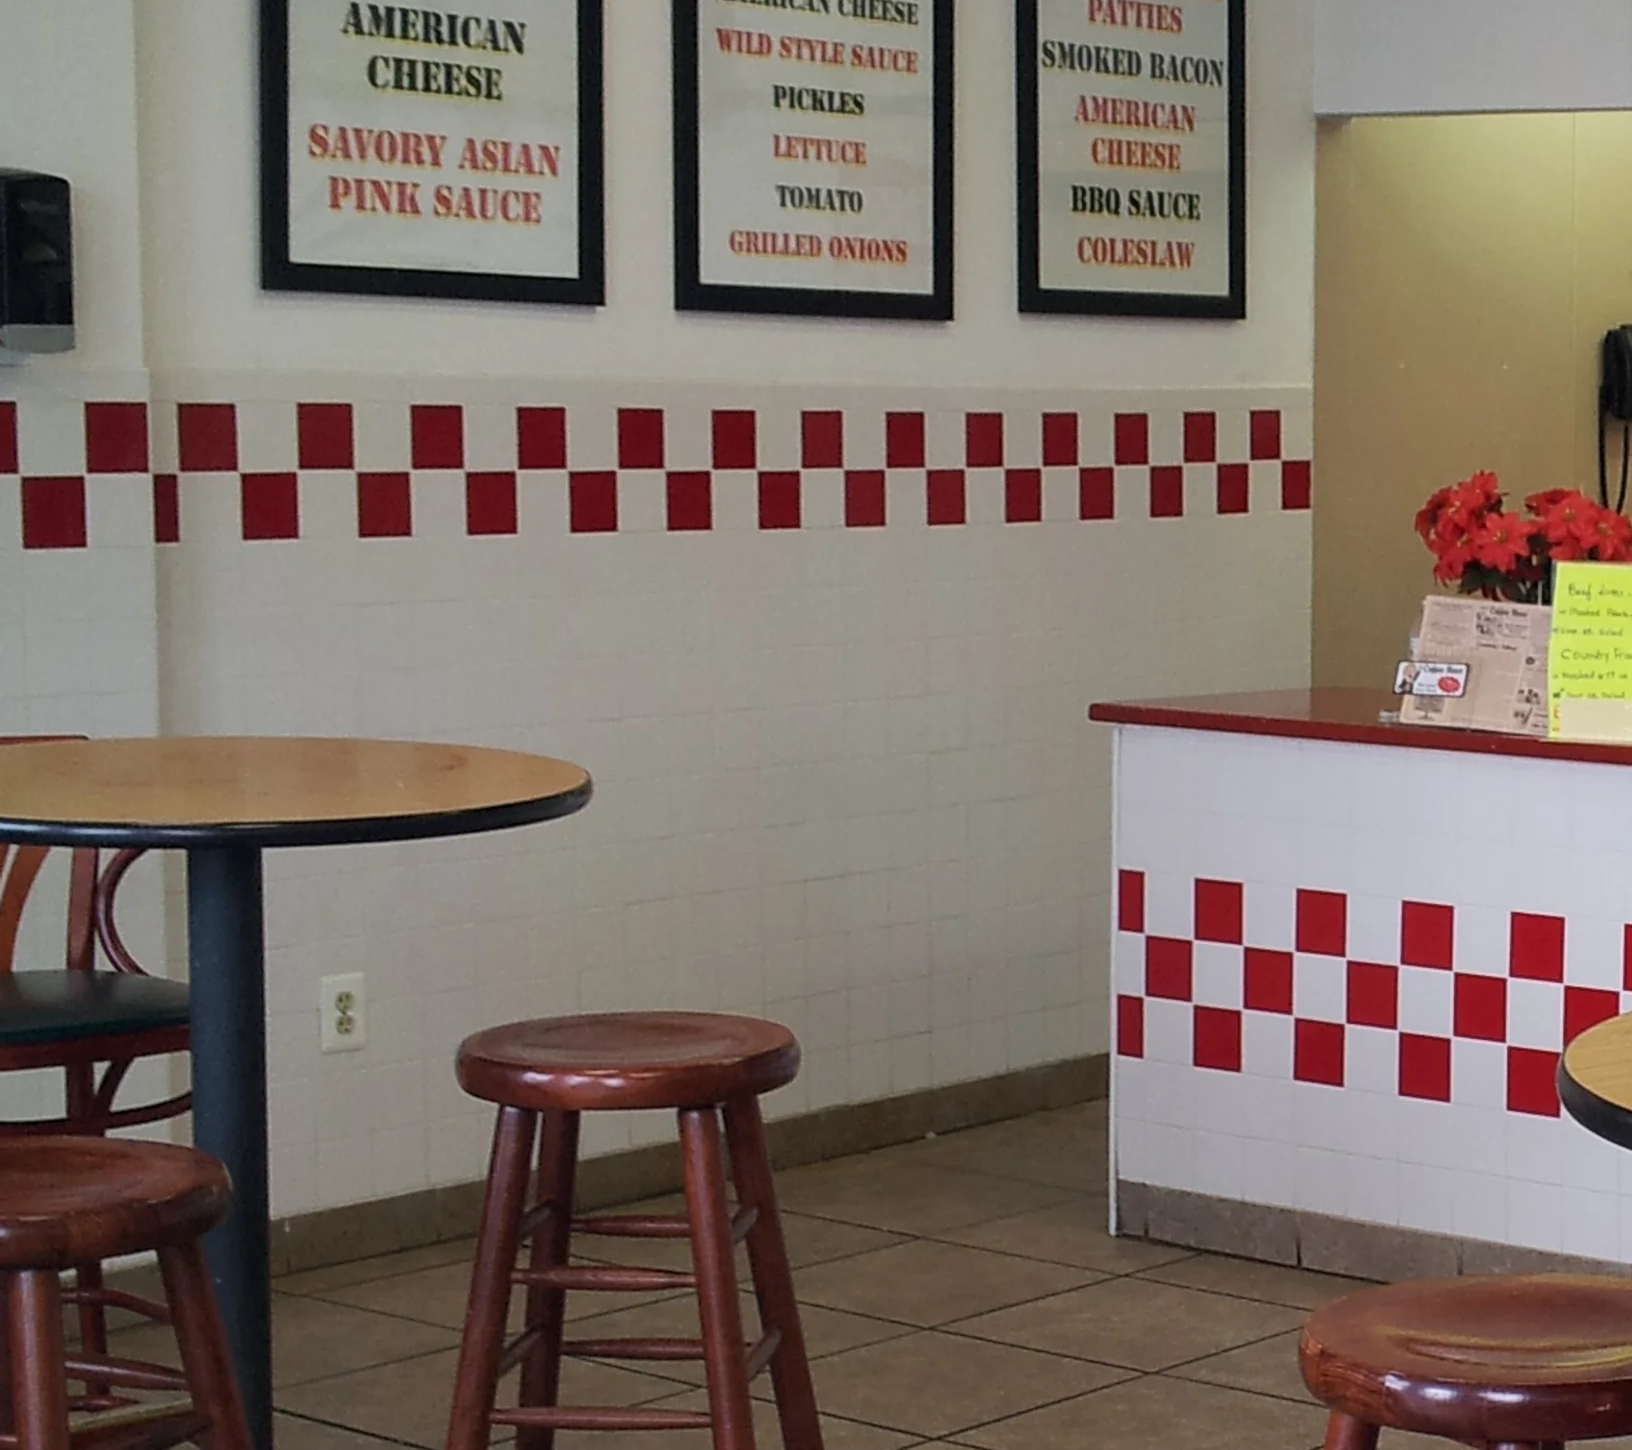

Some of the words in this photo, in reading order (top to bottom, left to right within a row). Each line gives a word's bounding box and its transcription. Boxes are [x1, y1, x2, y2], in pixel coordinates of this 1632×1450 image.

[342, 1, 527, 55] AMERICAN
[716, 28, 771, 57] WILD
[779, 36, 845, 65] STYLE
[851, 45, 918, 74] SAUCE
[1041, 40, 1142, 77] SMOKED
[1149, 52, 1224, 87] BACON
[367, 54, 503, 101] CHEESE
[772, 84, 865, 116] PICKLES
[1074, 94, 1196, 132] AMERICAN
[308, 123, 447, 169] SAVORY
[458, 137, 561, 178] ASIAN
[773, 134, 867, 165] LETTUCE
[1091, 137, 1182, 171] CHEESE
[329, 175, 421, 216] PINK
[432, 185, 542, 225] SAUCE
[776, 184, 863, 213] TOMATO
[1071, 185, 1121, 216] BBQ
[1128, 189, 1201, 221] SAUCE
[729, 230, 822, 257] GRILLED
[829, 235, 908, 263] ONIONS
[1077, 236, 1195, 268] COLESLAW
